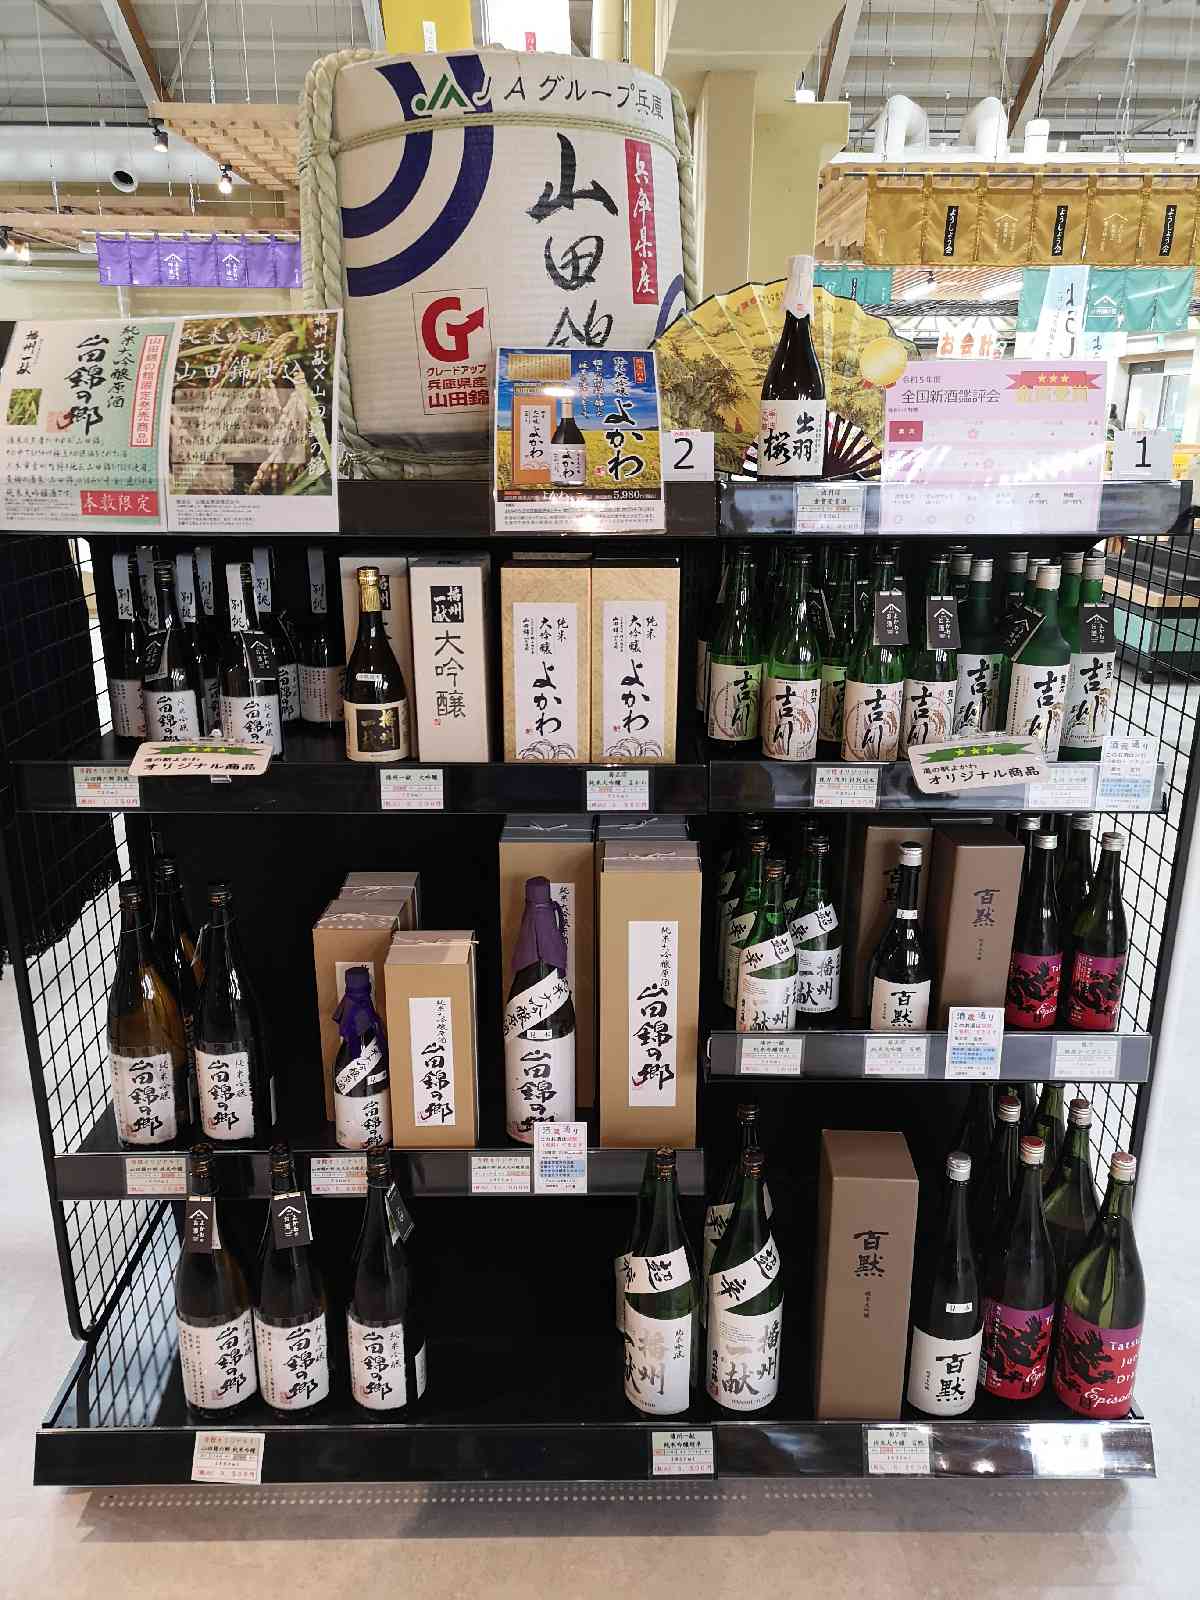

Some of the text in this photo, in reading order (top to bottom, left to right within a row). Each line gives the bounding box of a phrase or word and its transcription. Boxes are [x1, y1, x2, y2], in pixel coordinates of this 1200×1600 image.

[634, 151, 657, 295] 兵庫県産
[427, 378, 489, 391] 兵庫県産
[428, 391, 490, 408] 山田錦
[901, 389, 1000, 404] 全国新酒鑑評会
[604, 398, 644, 481] よかわ
[673, 438, 694, 470] 2
[796, 411, 815, 462] 出羽
[1135, 436, 1152, 468] 1
[82, 493, 151, 513] 本数限定
[435, 630, 466, 718] 大吟醸
[532, 661, 562, 737] よかわ
[620, 659, 650, 733] よかわ
[1077, 656, 1104, 735] 吉川
[773, 685, 796, 754] 吉川
[862, 689, 886, 760] 吉川
[1029, 671, 1058, 752] 吉川
[928, 766, 1040, 785] オリジナル商品
[972, 888, 1001, 928] 百黙
[632, 983, 674, 1091] 山田錦の郷
[890, 990, 917, 1027] 百黙
[128, 1059, 163, 1136] 山田錦の郷
[207, 1059, 237, 1134] 山田錦の郷
[421, 1042, 453, 1122] 山田錦の郷
[853, 1230, 889, 1278] 百黙
[215, 1327, 247, 1395] 山田錦の郷
[285, 1327, 318, 1400] 山田錦の郷
[362, 1331, 393, 1400] 山田錦の郷
[935, 1351, 972, 1402] 百黙
